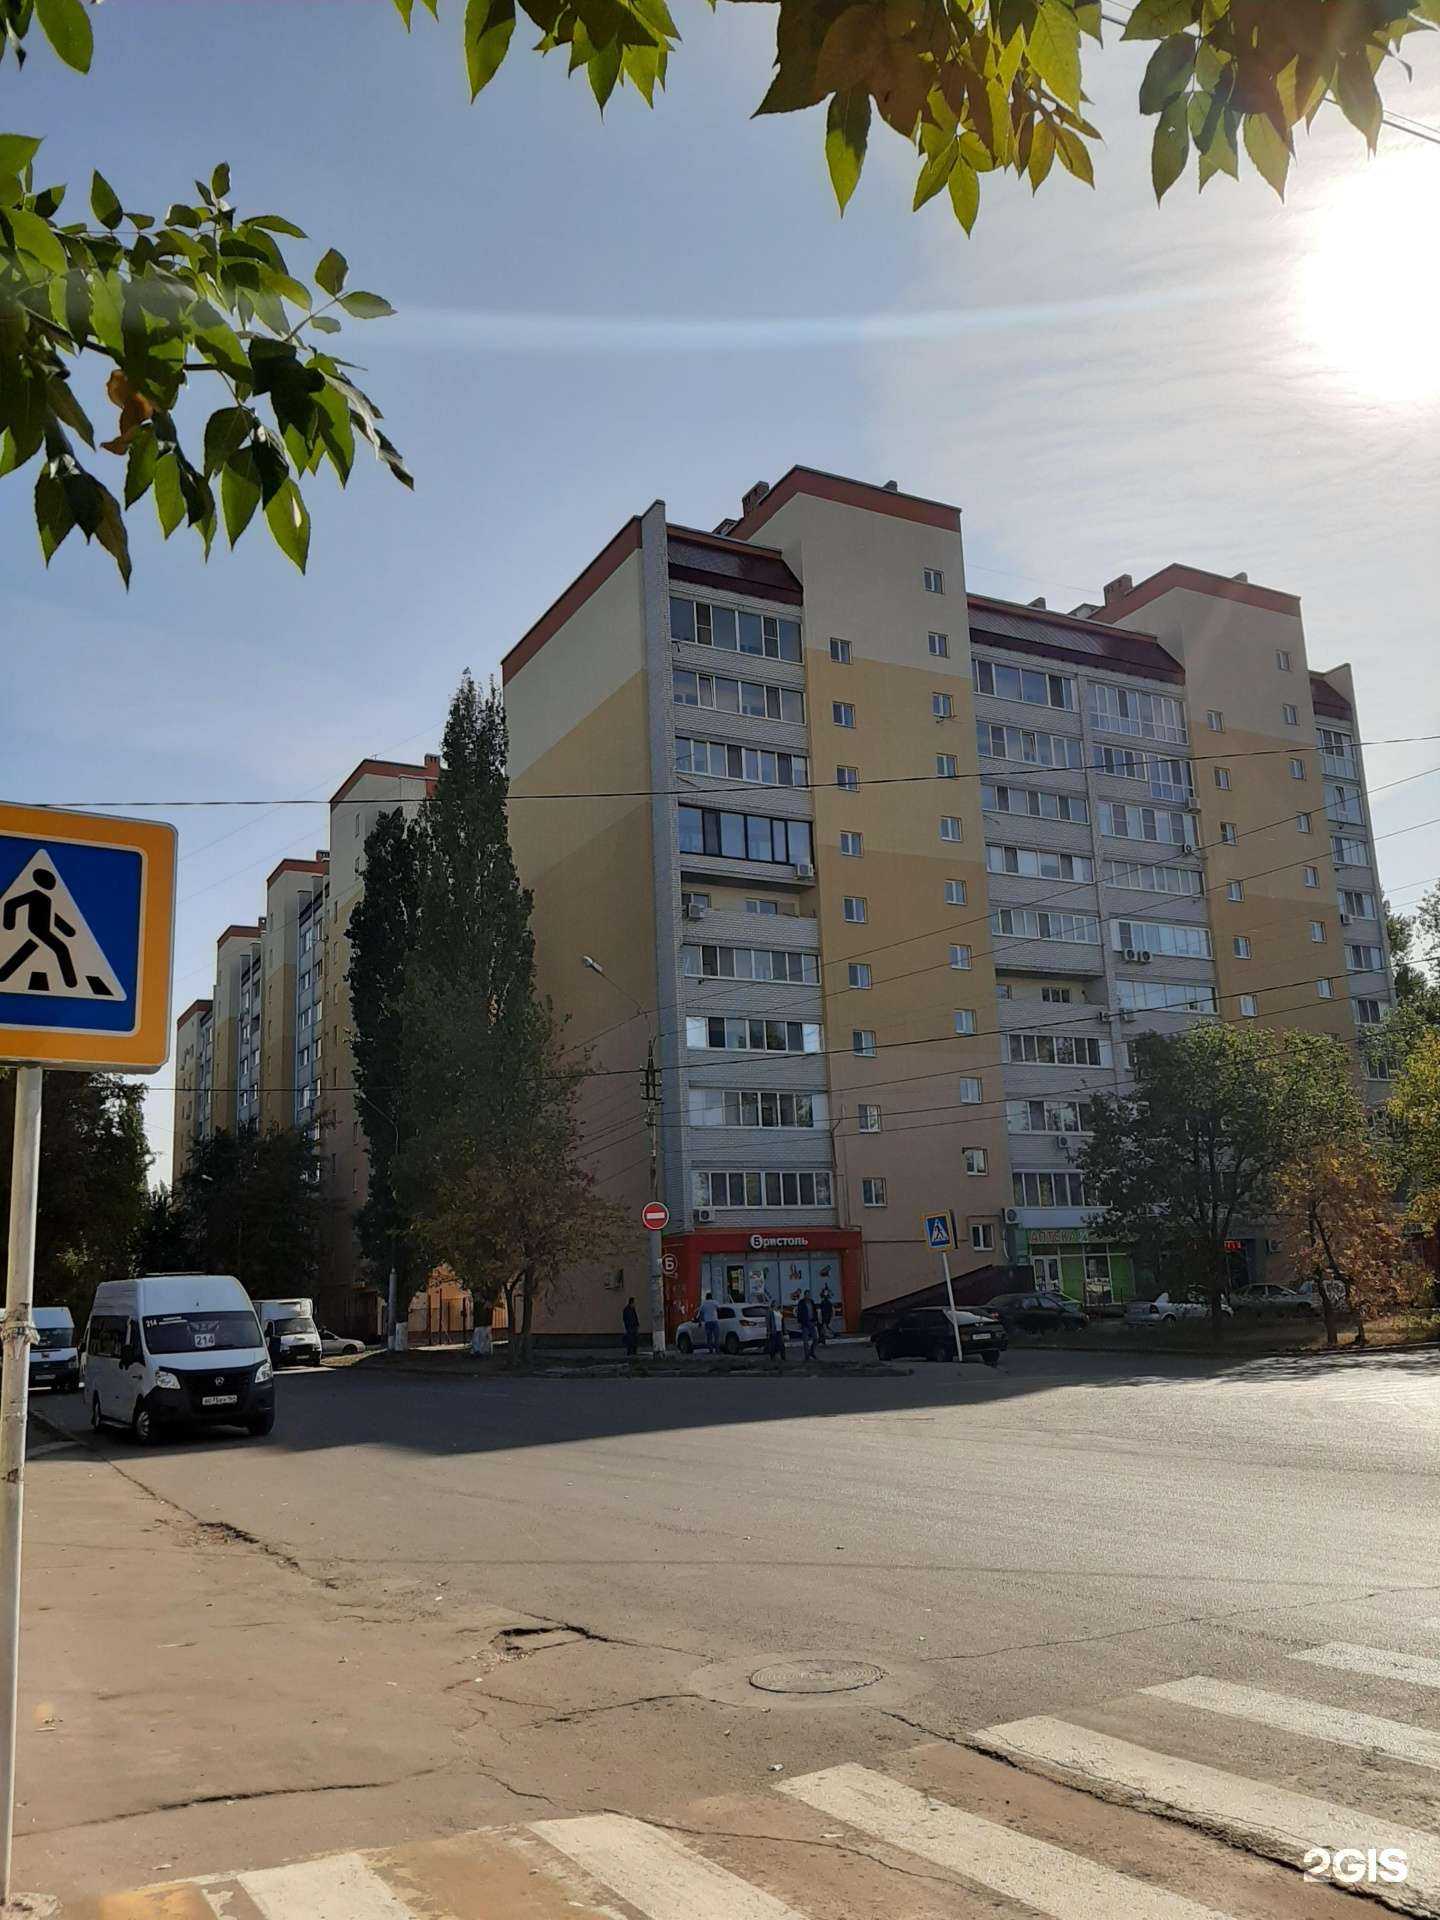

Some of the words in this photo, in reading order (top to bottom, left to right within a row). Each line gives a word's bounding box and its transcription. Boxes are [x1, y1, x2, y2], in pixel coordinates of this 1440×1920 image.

[750, 1234, 809, 1249] Бристоль
[145, 1319, 158, 1328] 214
[196, 1335, 214, 1346] 214
